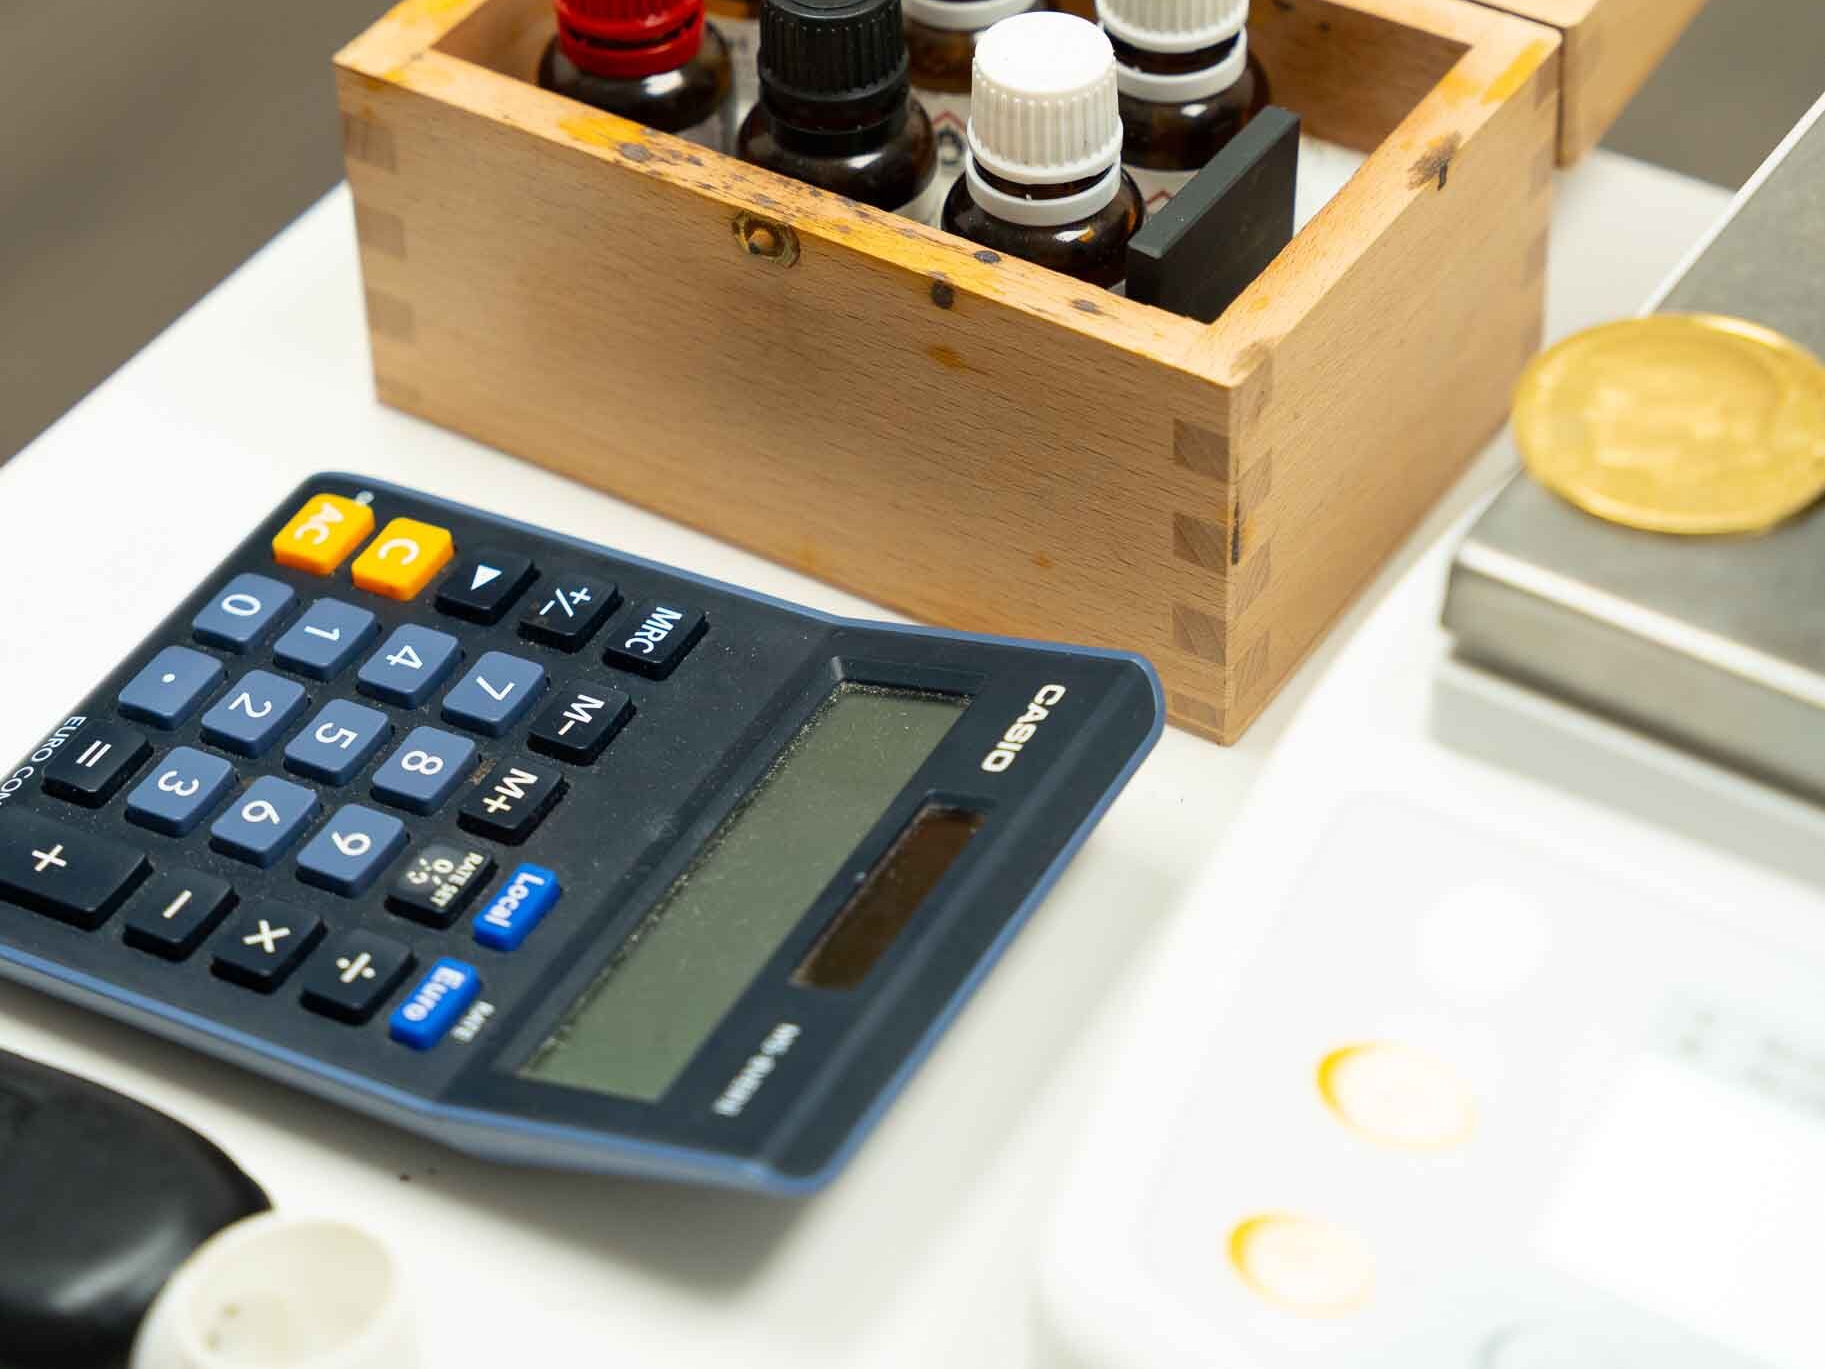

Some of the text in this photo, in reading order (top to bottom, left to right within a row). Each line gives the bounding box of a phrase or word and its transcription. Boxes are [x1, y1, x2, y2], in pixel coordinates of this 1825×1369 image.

[293, 502, 345, 546] AC
[377, 538, 420, 565] C
[221, 593, 261, 616] 0
[304, 625, 340, 641] 1
[624, 606, 683, 654] MRC
[386, 645, 423, 669] 4
[476, 676, 515, 701] 7
[228, 692, 272, 718] 2
[31, 716, 88, 762] EURO
[315, 722, 358, 749] 5
[981, 684, 1066, 772] CASIO
[401, 750, 444, 776] 8
[157, 770, 200, 797] 3
[482, 767, 539, 813] M+
[241, 800, 281, 824] 6
[331, 831, 371, 856] 9
[484, 872, 545, 928] Local
[402, 966, 467, 1022] Euro
